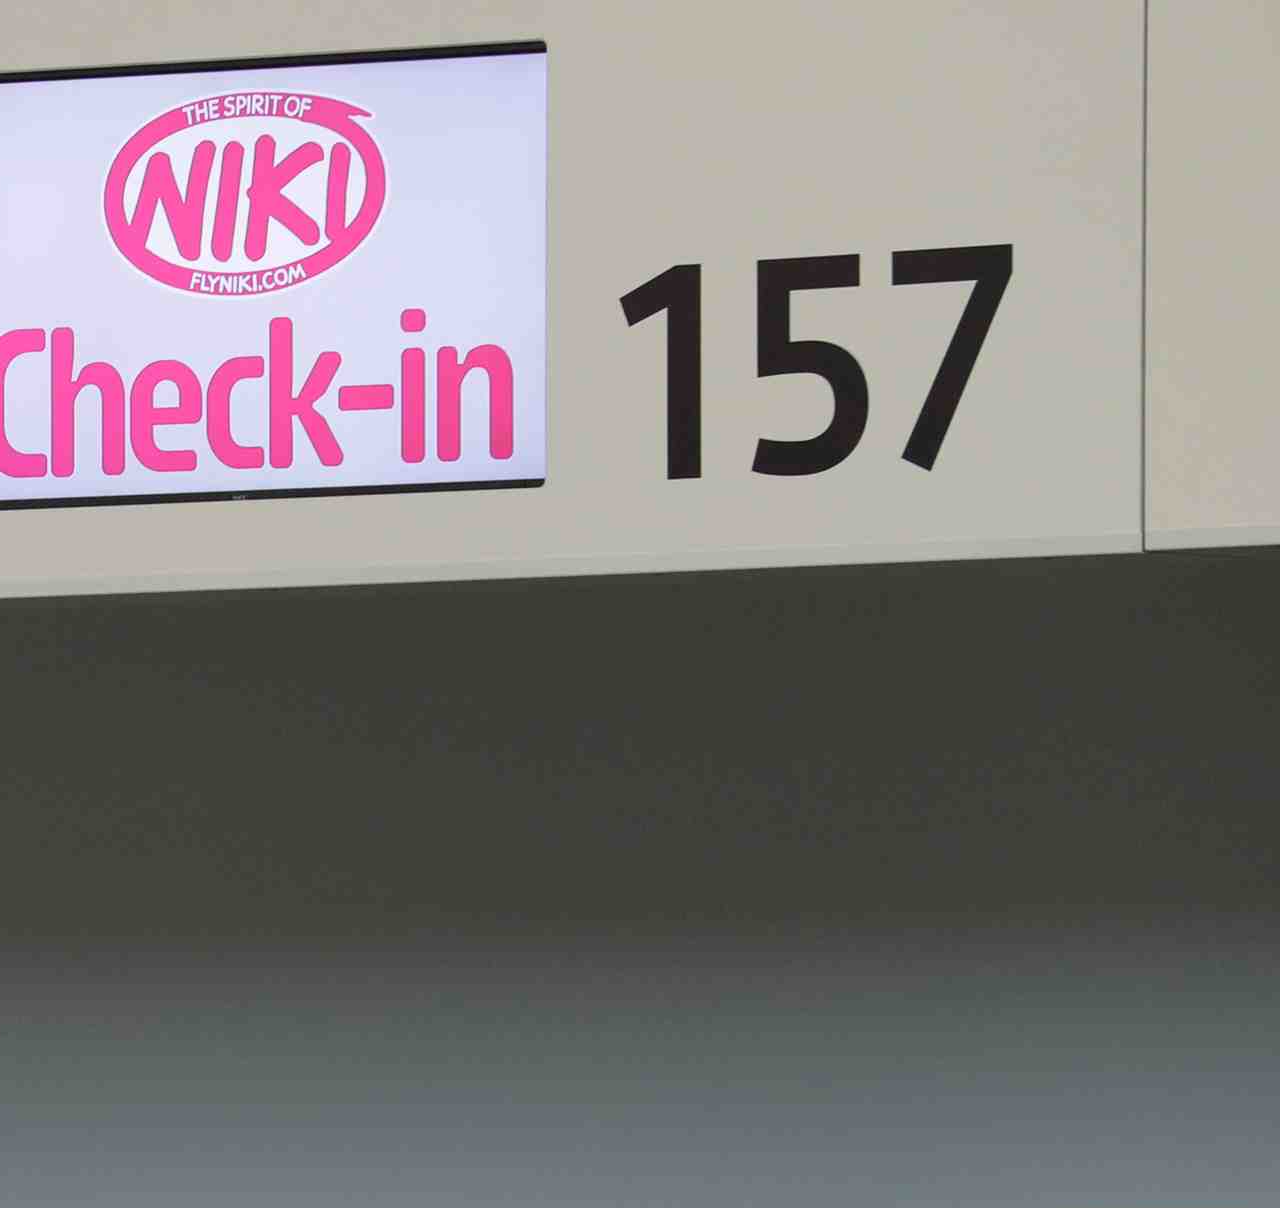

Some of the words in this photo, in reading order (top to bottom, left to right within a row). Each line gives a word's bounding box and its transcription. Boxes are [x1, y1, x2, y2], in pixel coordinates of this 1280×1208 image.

[182, 98, 220, 125] THE
[223, 94, 282, 117] SPIRIT
[283, 96, 313, 118] OF
[128, 134, 352, 262] NIKI
[189, 263, 308, 293] FLYNIKI.COM
[619, 244, 1013, 480] 157
